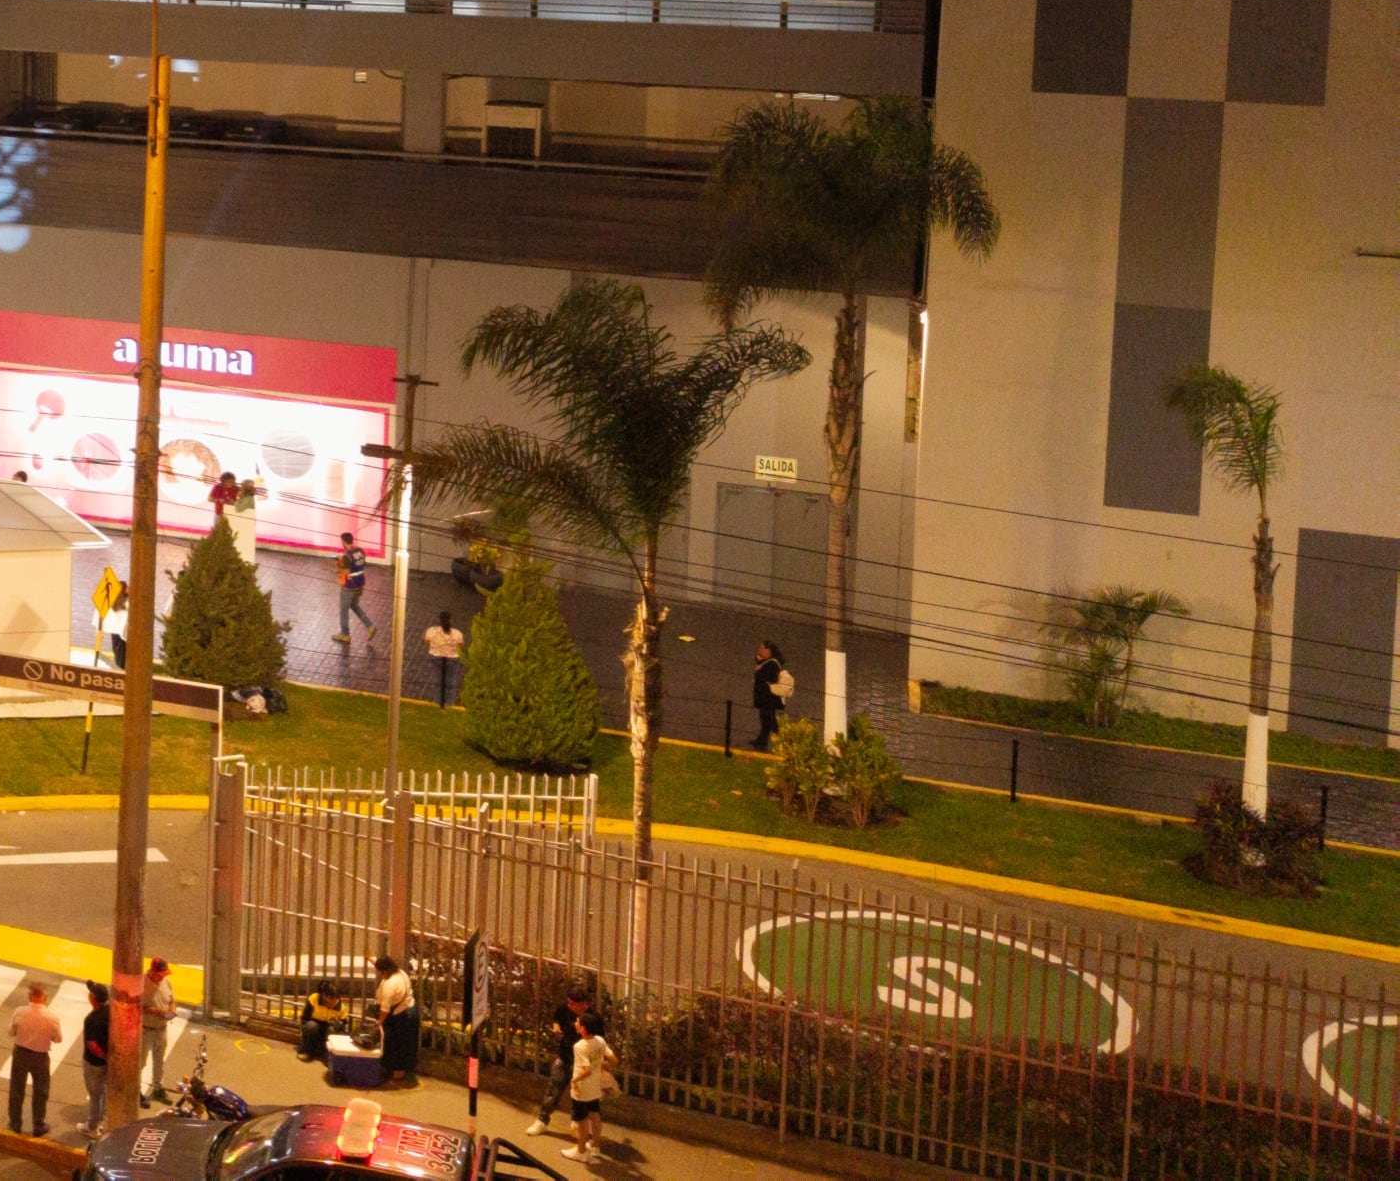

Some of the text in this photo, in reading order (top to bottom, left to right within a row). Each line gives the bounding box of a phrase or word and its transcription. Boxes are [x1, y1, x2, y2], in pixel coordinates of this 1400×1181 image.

[113, 338, 253, 375] auma
[759, 459, 794, 473] SALIDA
[50, 665, 76, 682] No
[80, 672, 125, 691] pasa
[877, 956, 982, 1018] S
[396, 1128, 431, 1158] TMP
[425, 1131, 462, 1173] 3452
